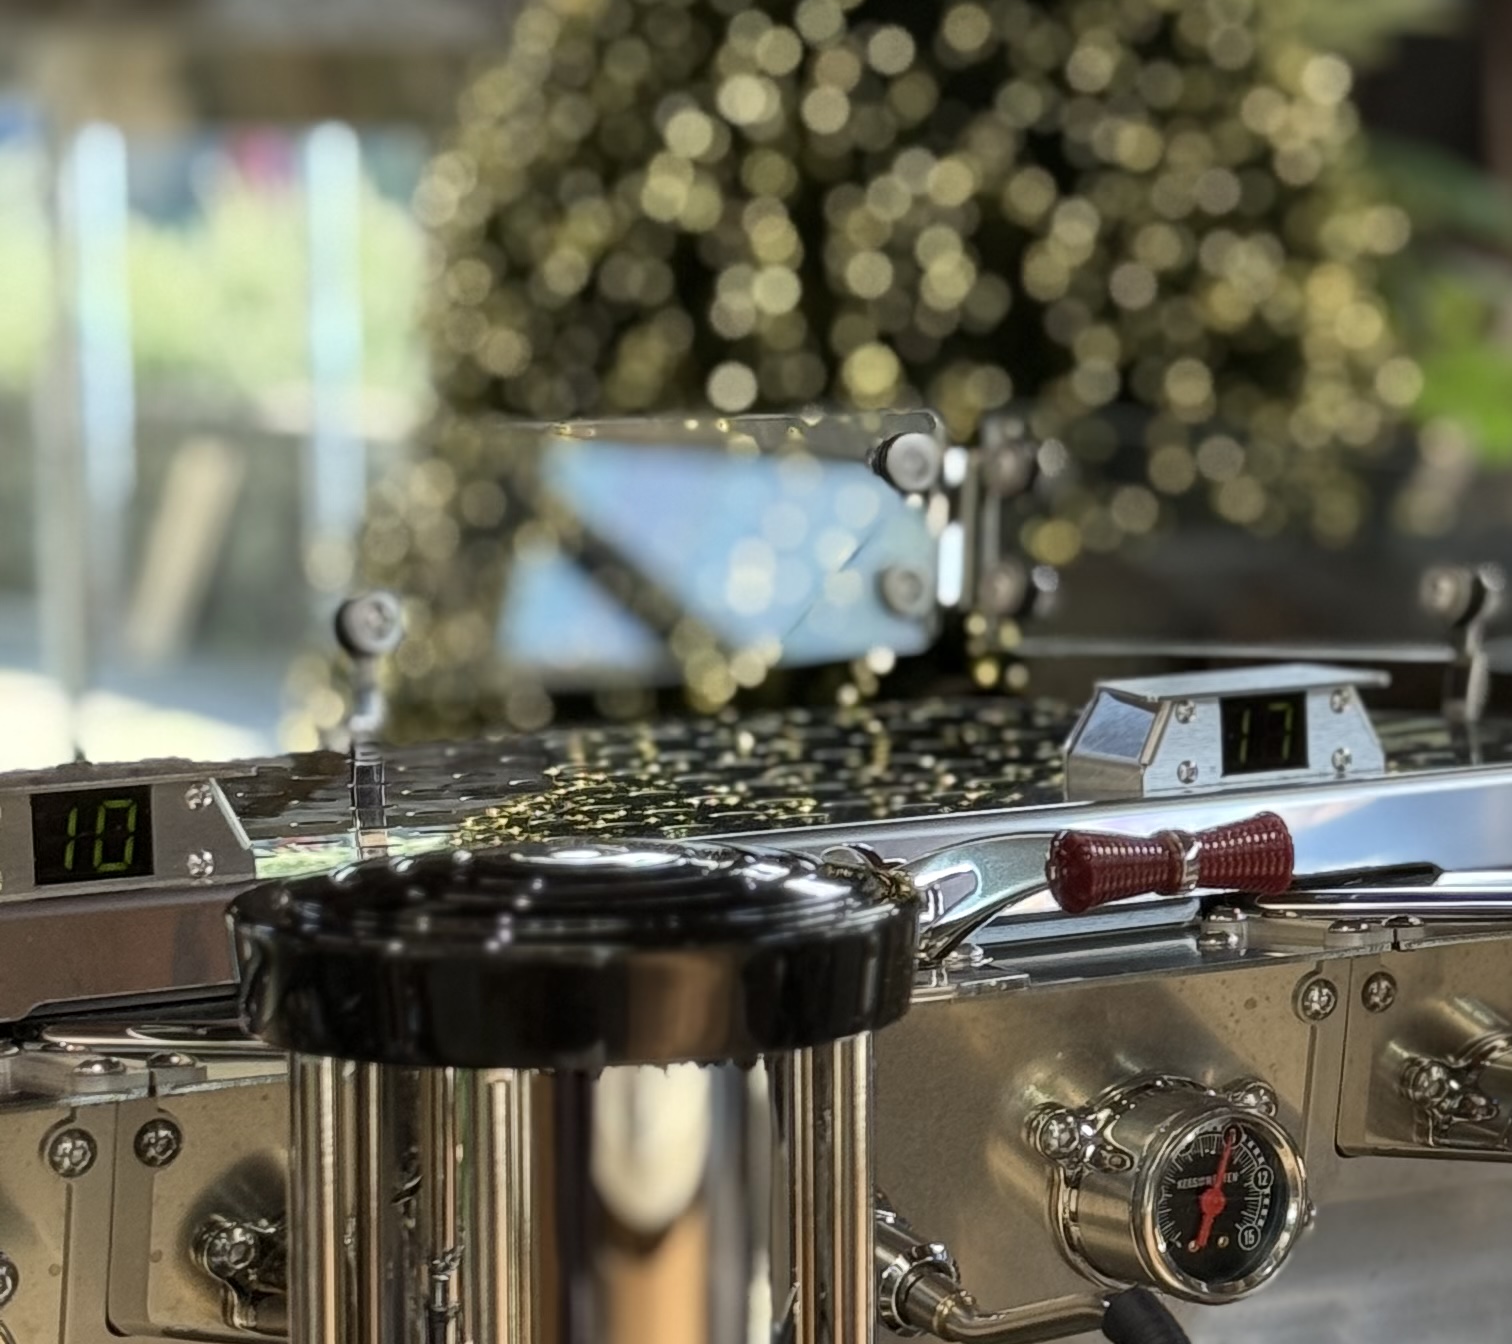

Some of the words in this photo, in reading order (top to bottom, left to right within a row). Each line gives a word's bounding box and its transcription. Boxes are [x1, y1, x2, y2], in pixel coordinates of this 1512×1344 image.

[1239, 702, 1293, 764] 17
[64, 799, 137, 872] 10
[1257, 1170, 1268, 1186] 12
[1243, 1229, 1255, 1245] 15
